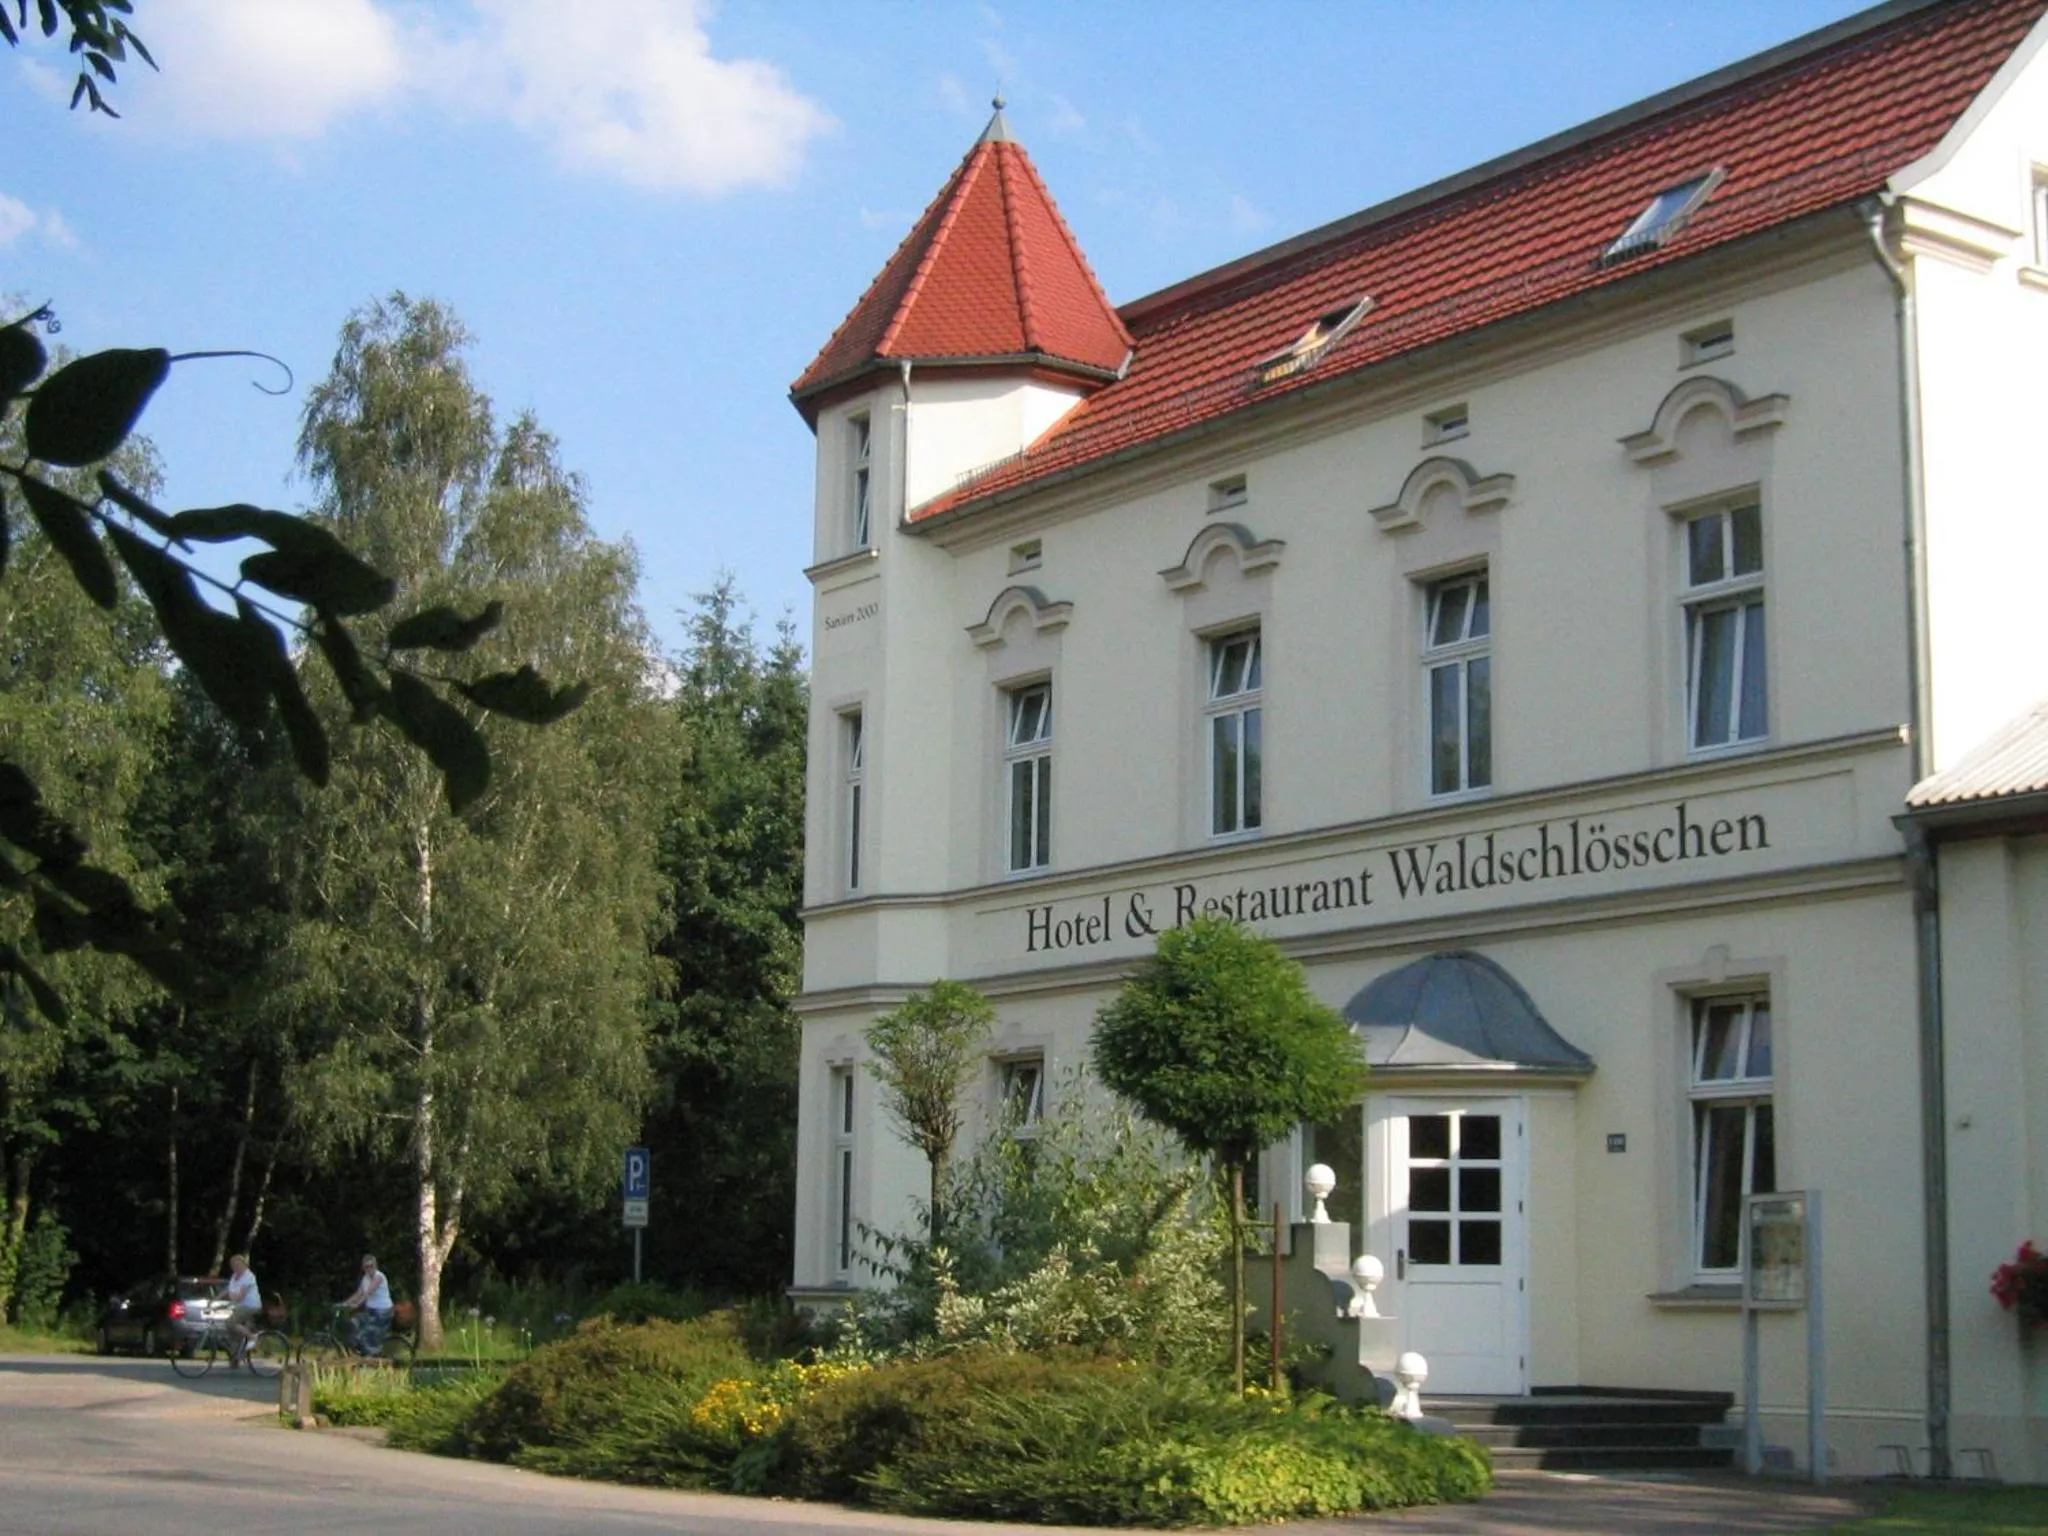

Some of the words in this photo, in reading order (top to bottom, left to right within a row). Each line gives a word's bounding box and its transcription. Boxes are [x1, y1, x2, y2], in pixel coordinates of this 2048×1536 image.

[1026, 896, 1112, 952] Hotel
[1124, 892, 1157, 938] &
[1173, 867, 1374, 930] Restaurant
[1388, 802, 1770, 899] Waldschlösschen
[630, 1155, 643, 1192] P
